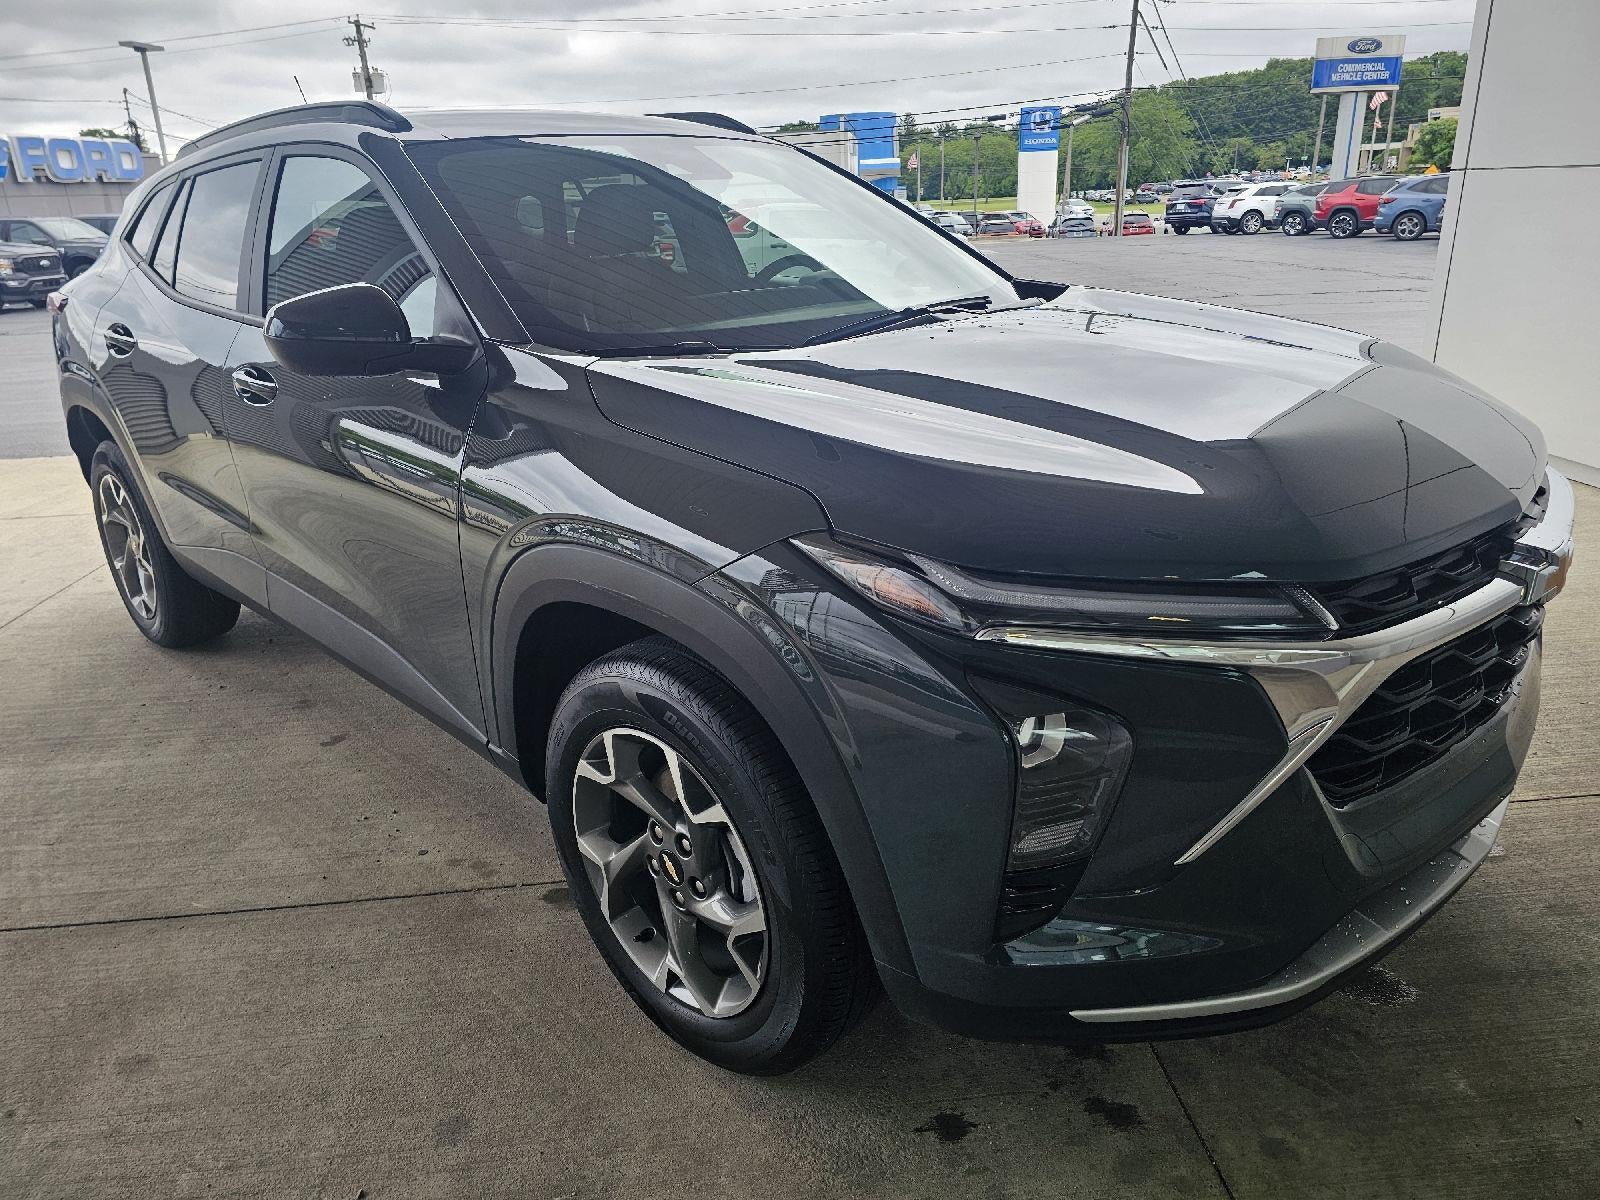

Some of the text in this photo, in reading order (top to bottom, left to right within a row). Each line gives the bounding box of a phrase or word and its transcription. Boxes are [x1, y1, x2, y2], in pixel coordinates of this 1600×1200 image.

[1355, 40, 1377, 51] Ford
[1337, 62, 1386, 73] COMMERCIAL
[1331, 70, 1390, 81] VEHICLE CENTER
[1024, 137, 1057, 145] HONDA
[12, 136, 144, 183] FORD
